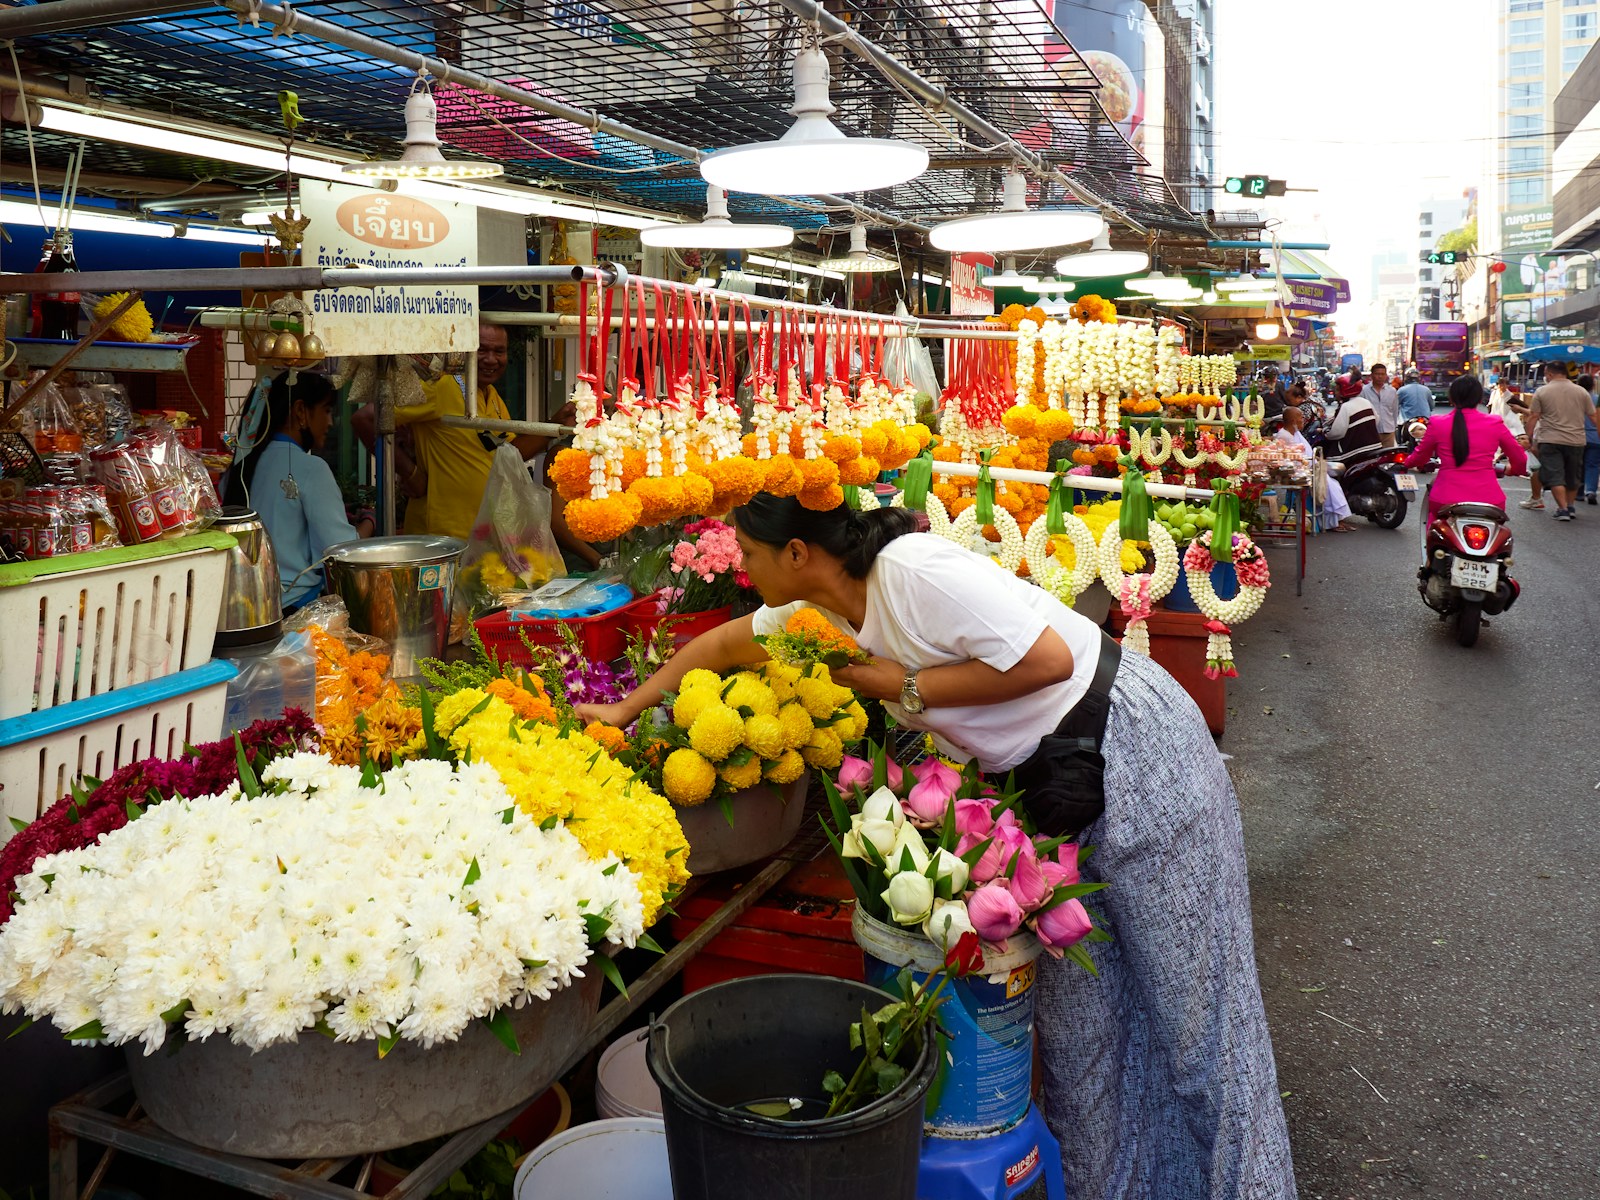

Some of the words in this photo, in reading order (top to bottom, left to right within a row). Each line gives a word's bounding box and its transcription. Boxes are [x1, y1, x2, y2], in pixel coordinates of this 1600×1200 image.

[1250, 179, 1264, 195] 12
[352, 197, 435, 243] เจี๊ยบ
[1444, 252, 1454, 263] 12
[1461, 578, 1487, 589] 225
[987, 1004, 1004, 1013] lasting
